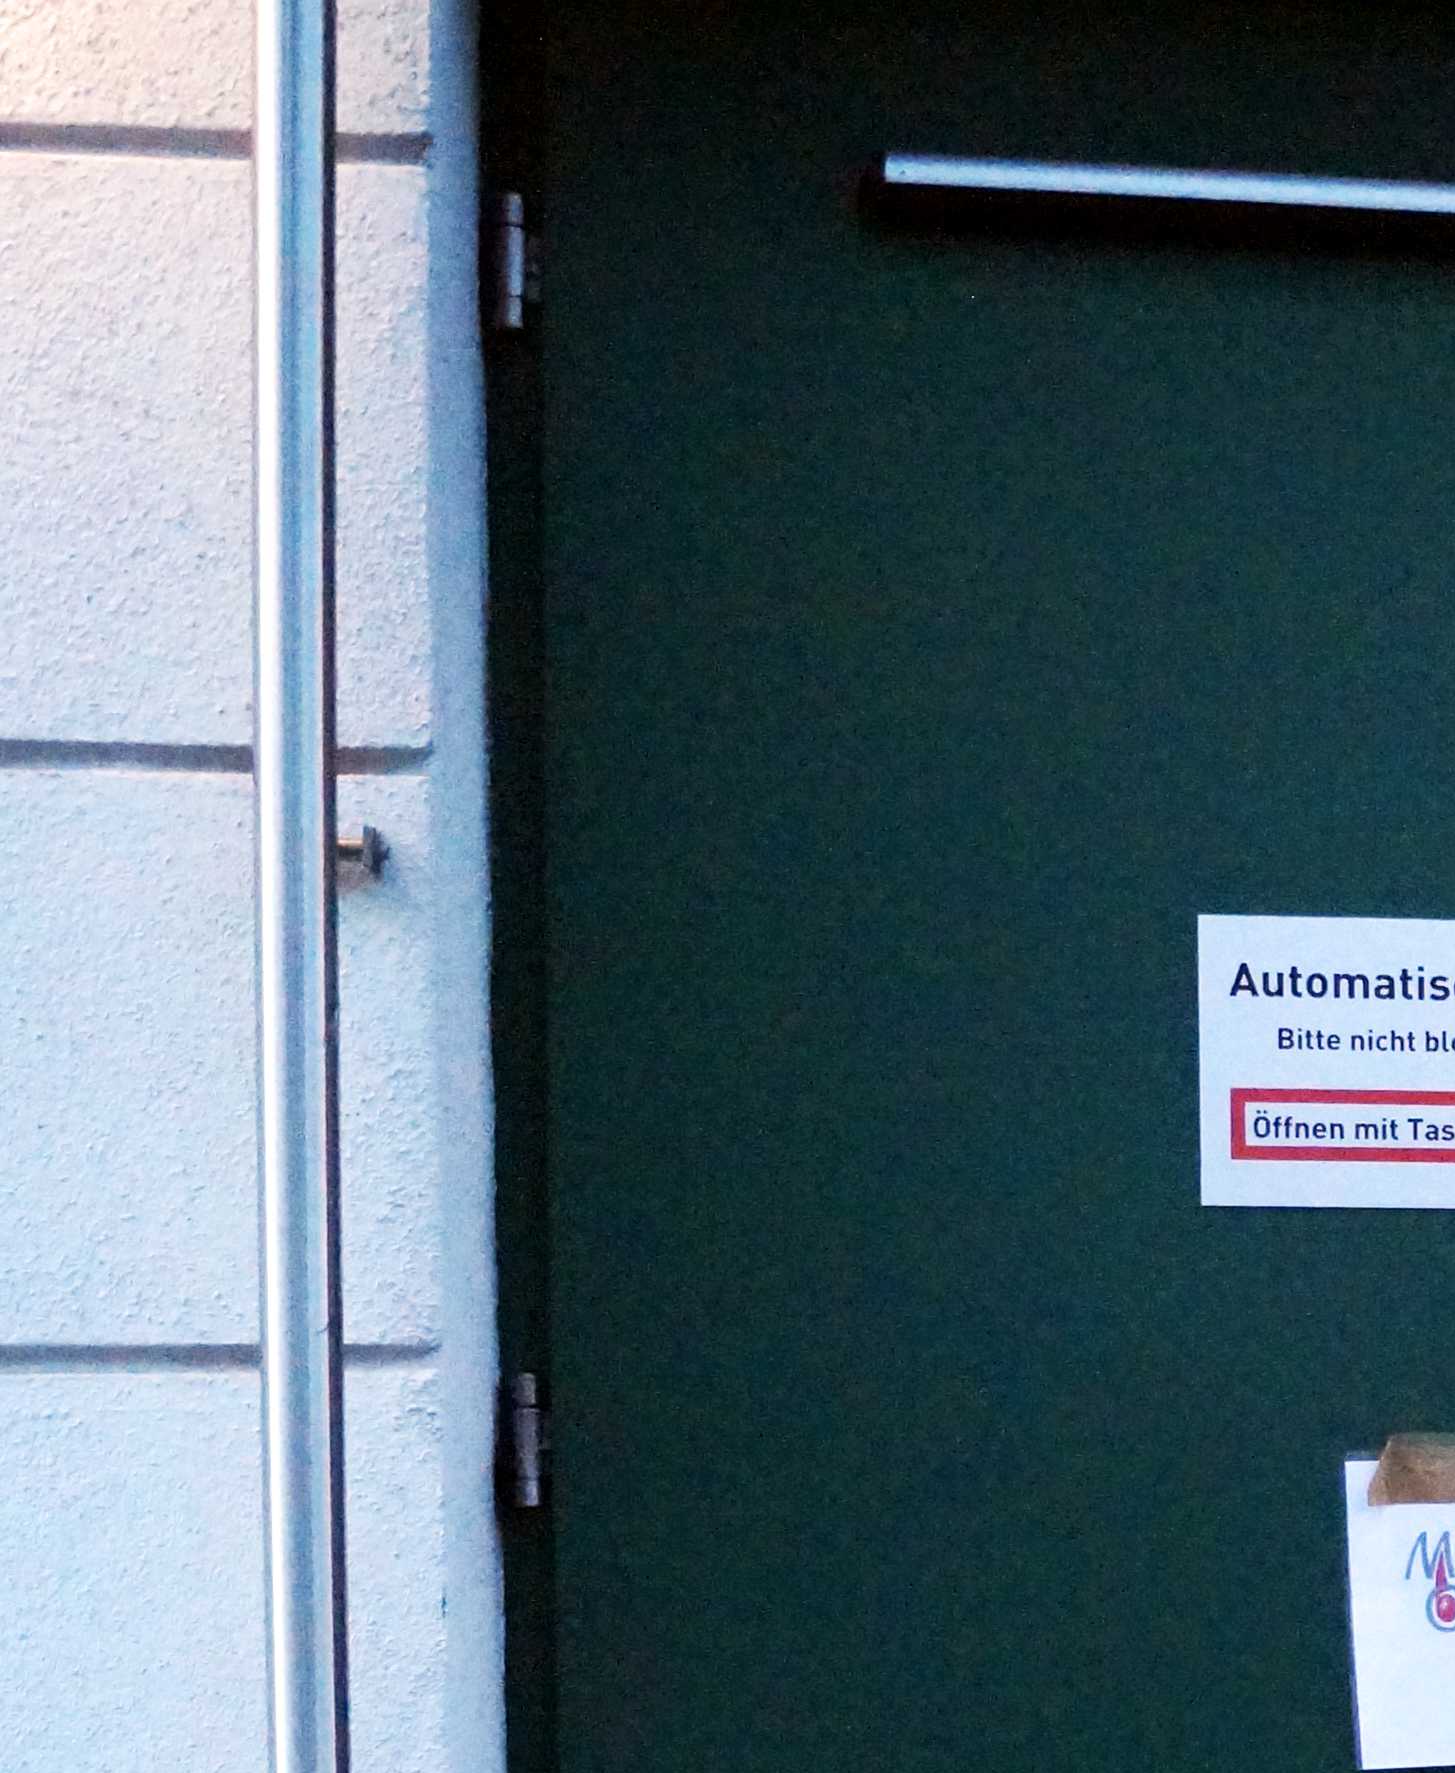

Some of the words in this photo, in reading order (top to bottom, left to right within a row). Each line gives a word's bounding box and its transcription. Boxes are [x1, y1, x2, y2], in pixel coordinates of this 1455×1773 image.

[1278, 1027, 1340, 1051] Bitte
[1351, 1029, 1415, 1053] nicht
[1253, 1110, 1345, 1140] Öffnen
[1354, 1117, 1398, 1141] mit
